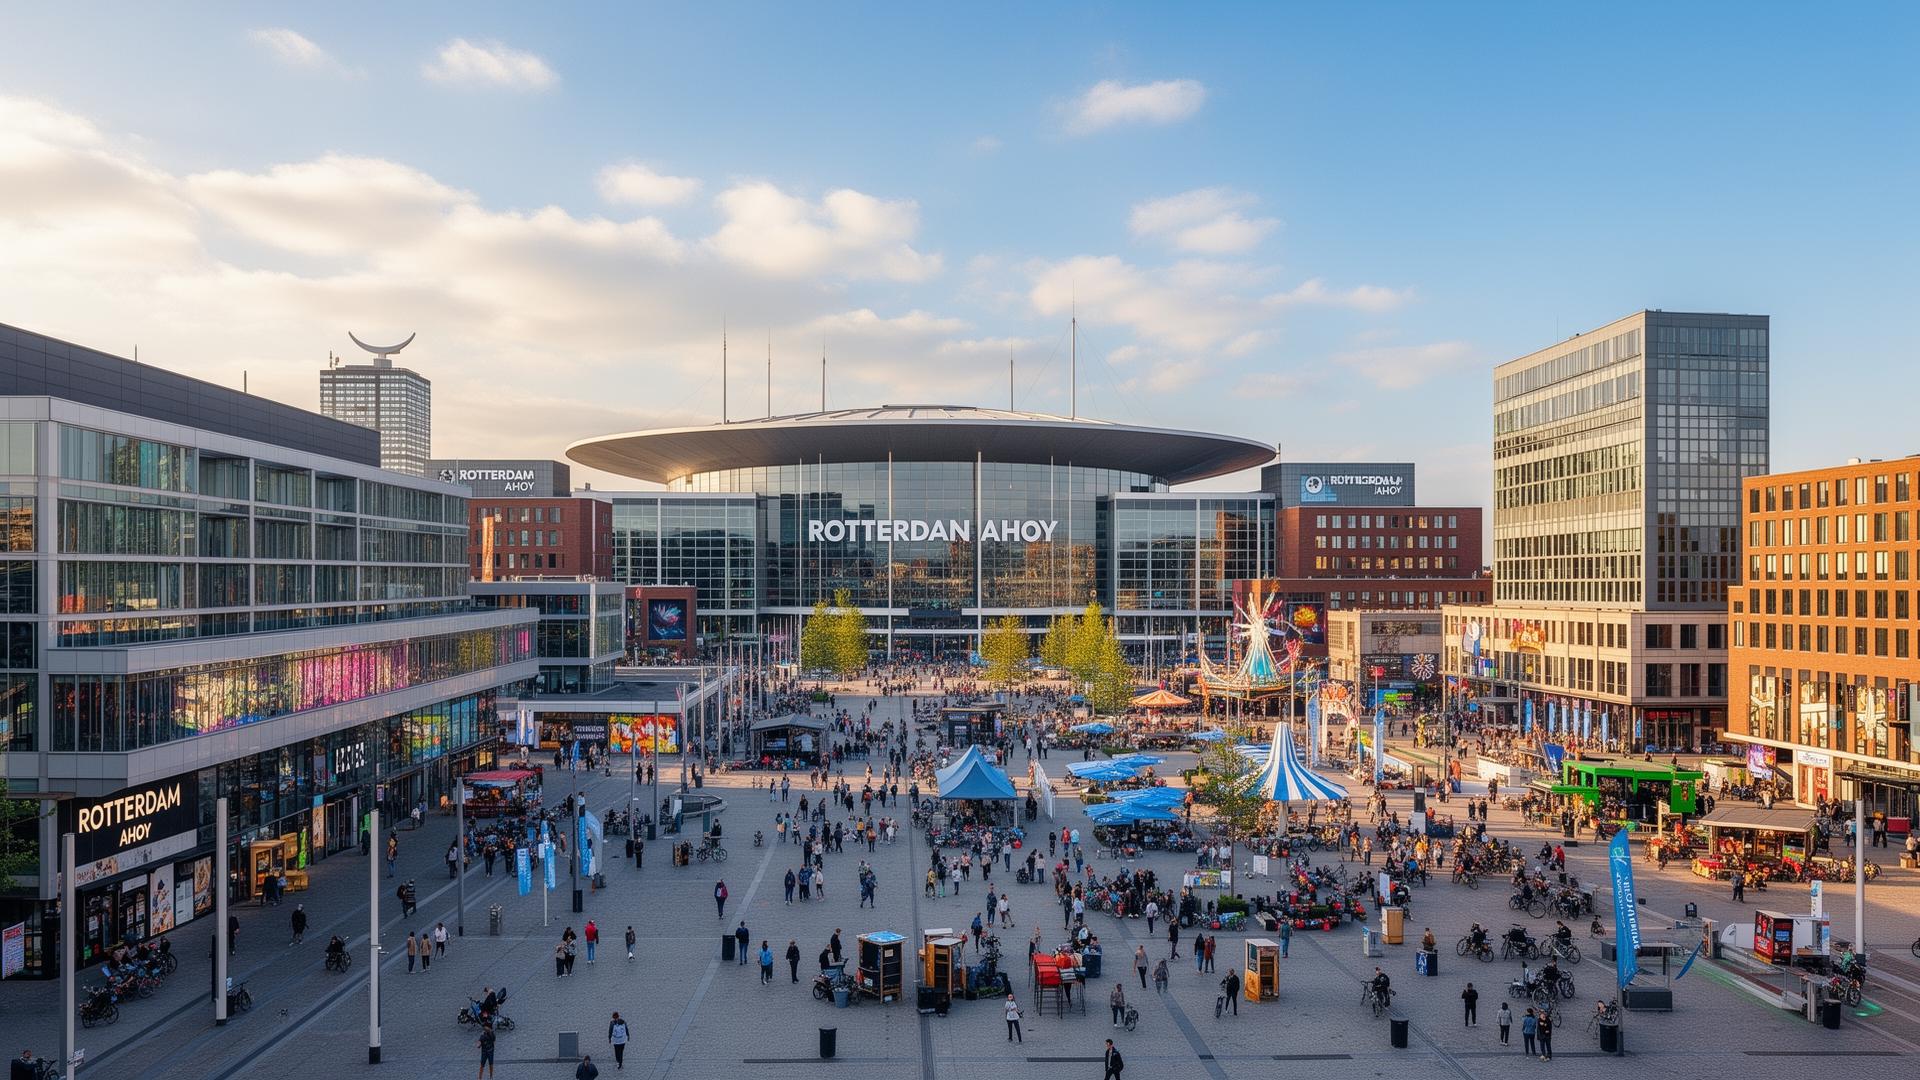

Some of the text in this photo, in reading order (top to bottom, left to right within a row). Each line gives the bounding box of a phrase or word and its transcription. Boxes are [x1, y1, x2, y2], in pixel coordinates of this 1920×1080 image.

[459, 469, 534, 480] ROTTERDAM
[504, 481, 534, 491] AHOY
[1376, 486, 1401, 495] AHOY
[808, 519, 1058, 542] ROTTERDAN AHOY
[79, 782, 181, 834] ROTTERDAM
[119, 822, 152, 847] AHOY
